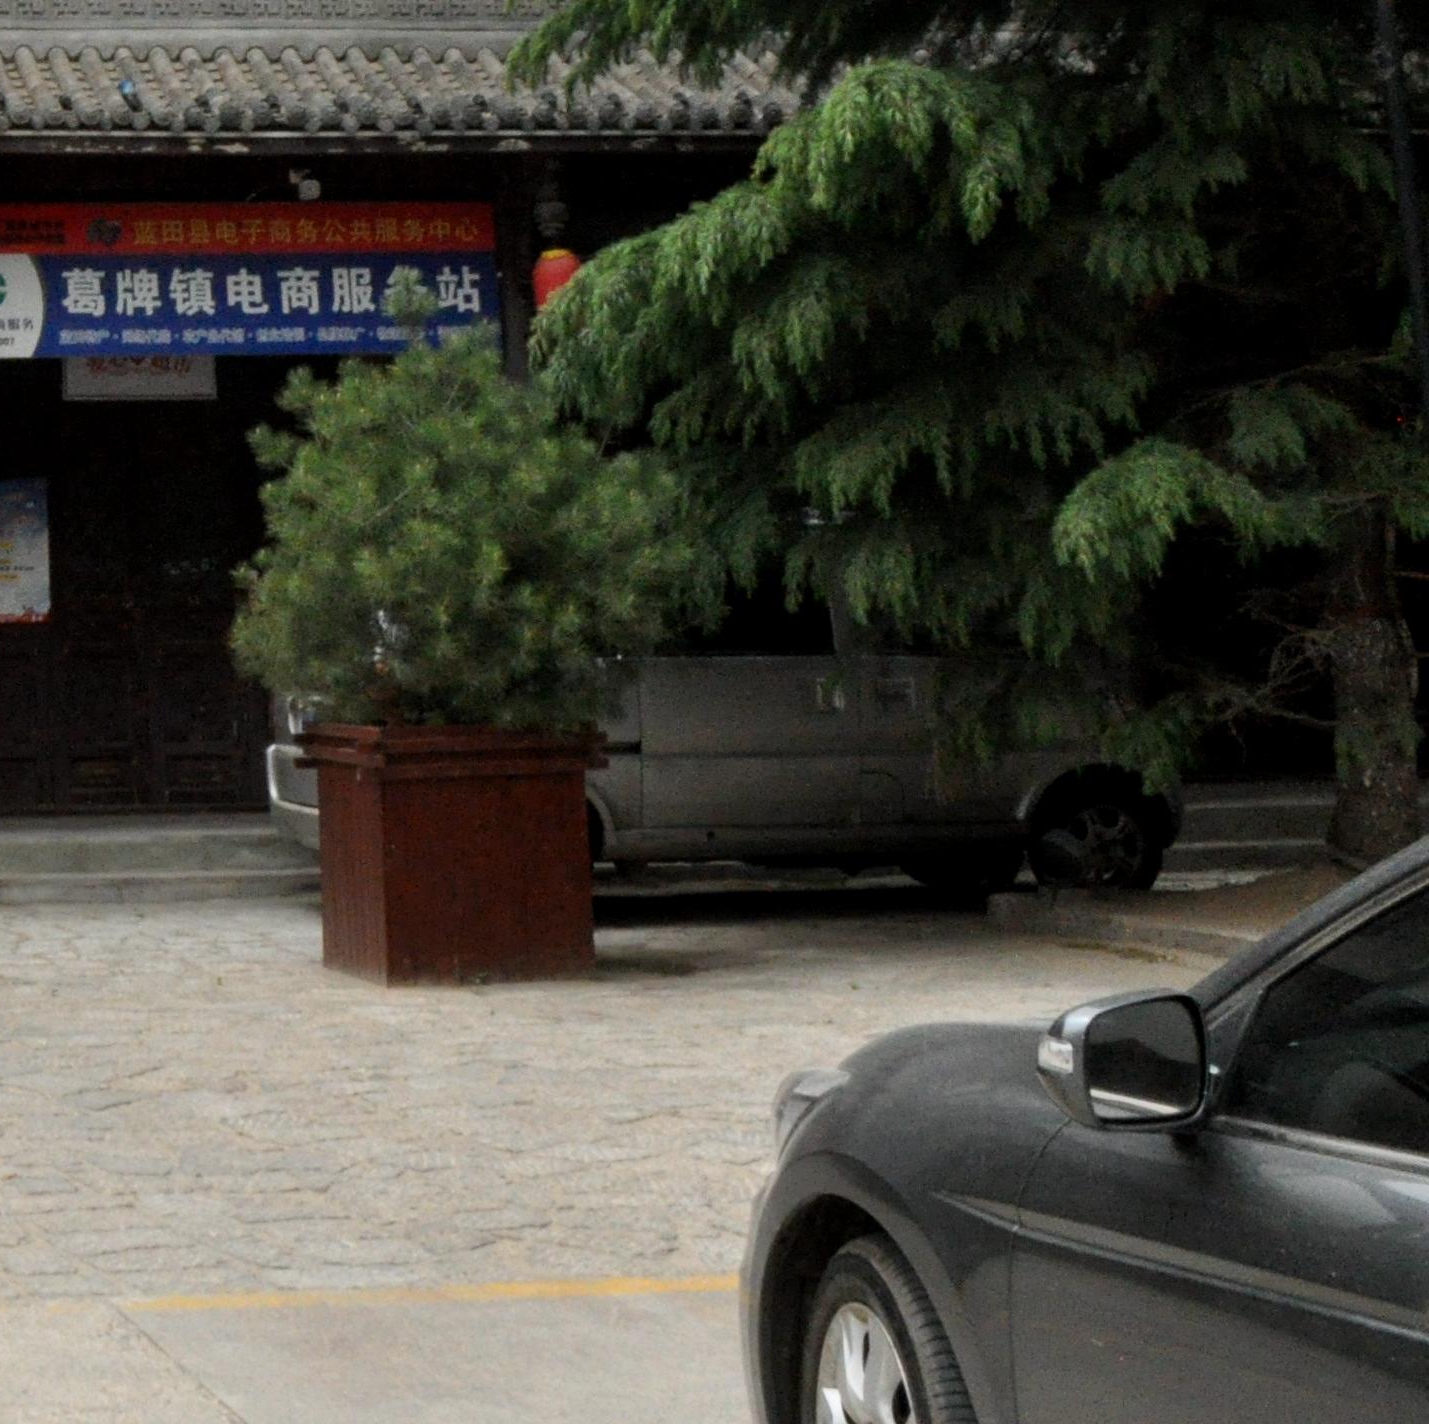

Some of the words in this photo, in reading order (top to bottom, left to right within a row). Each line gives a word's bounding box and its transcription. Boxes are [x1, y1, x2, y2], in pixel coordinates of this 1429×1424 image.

[132, 217, 479, 245] 蓝田县电子商务公共服务中心
